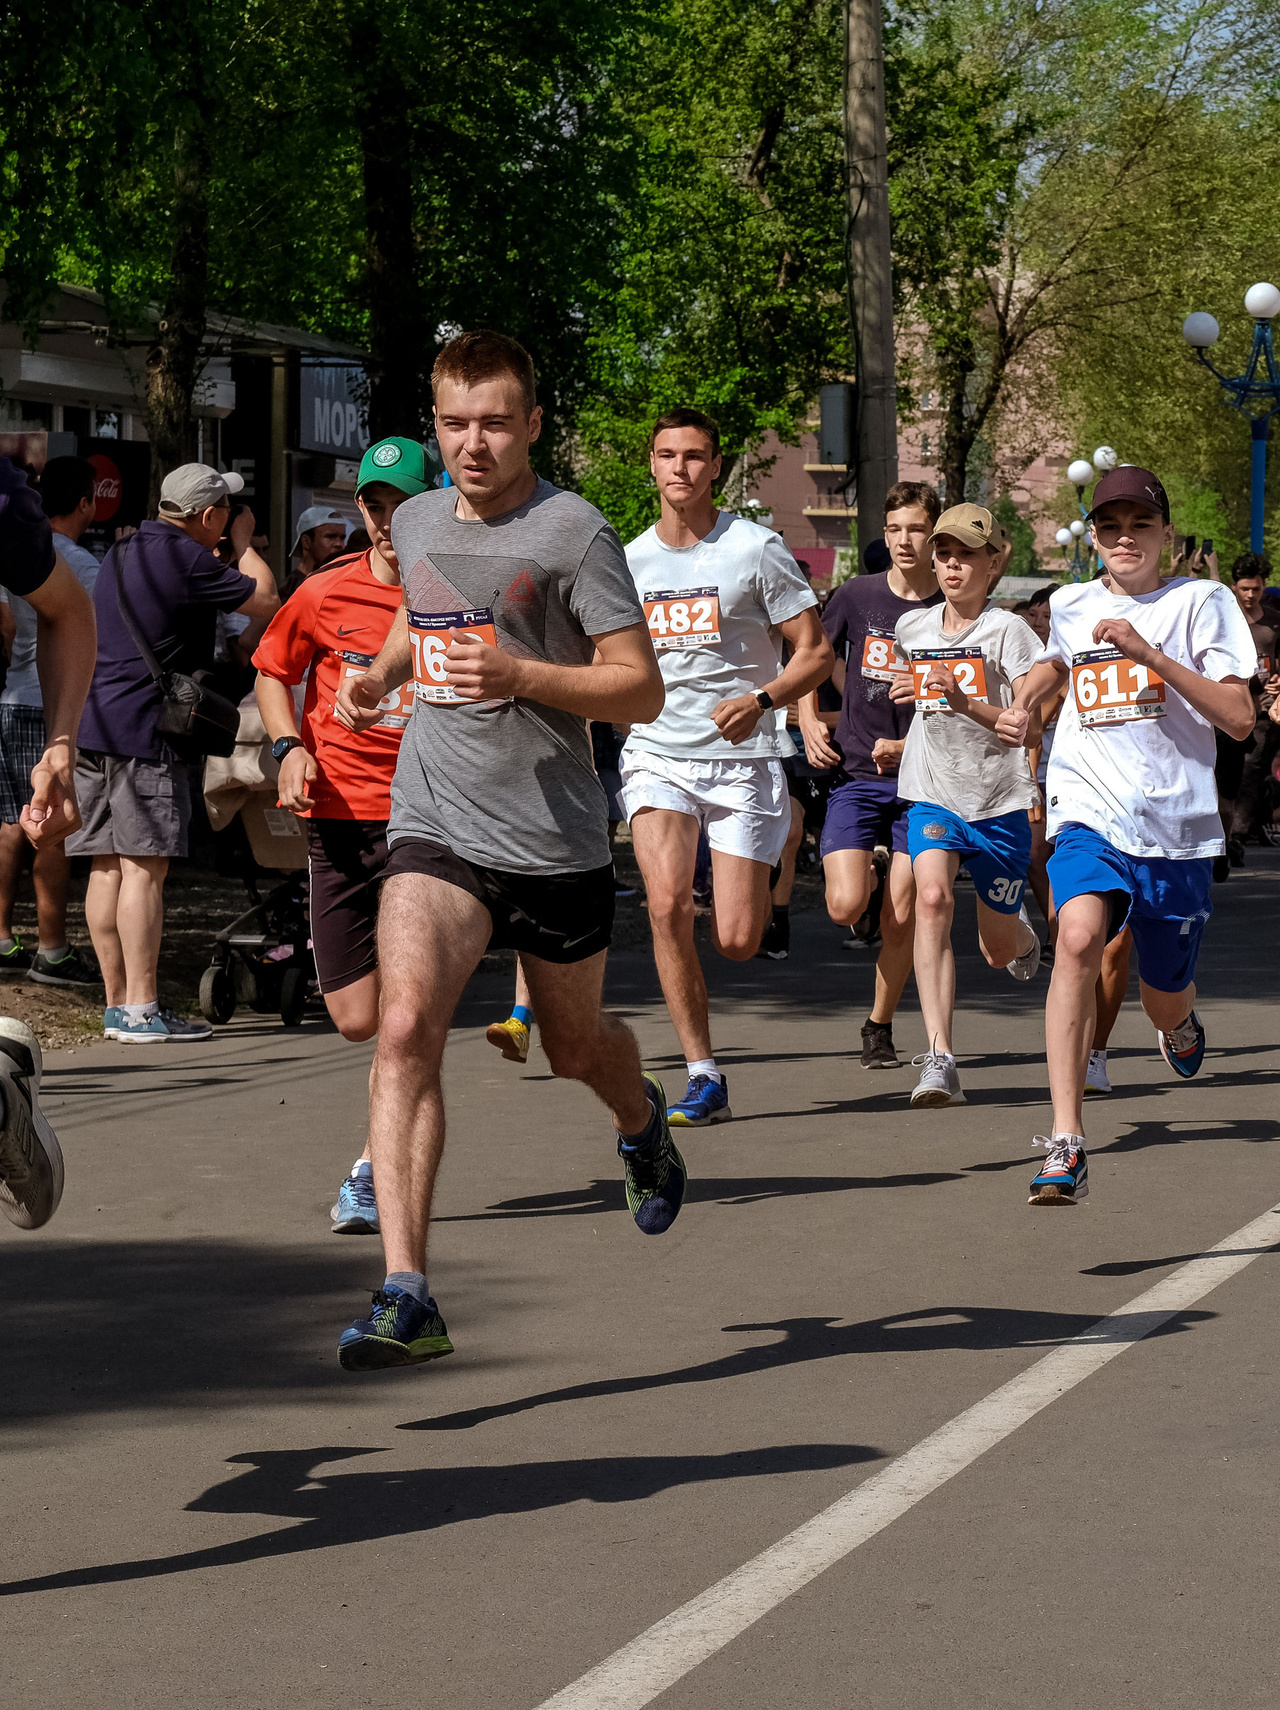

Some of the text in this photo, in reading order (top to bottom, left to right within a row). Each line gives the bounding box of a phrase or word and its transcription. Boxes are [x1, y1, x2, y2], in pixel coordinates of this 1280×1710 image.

[648, 600, 713, 635] 482
[915, 662, 978, 697] 72
[1077, 664, 1159, 708] 611
[988, 877, 1023, 905] 30
